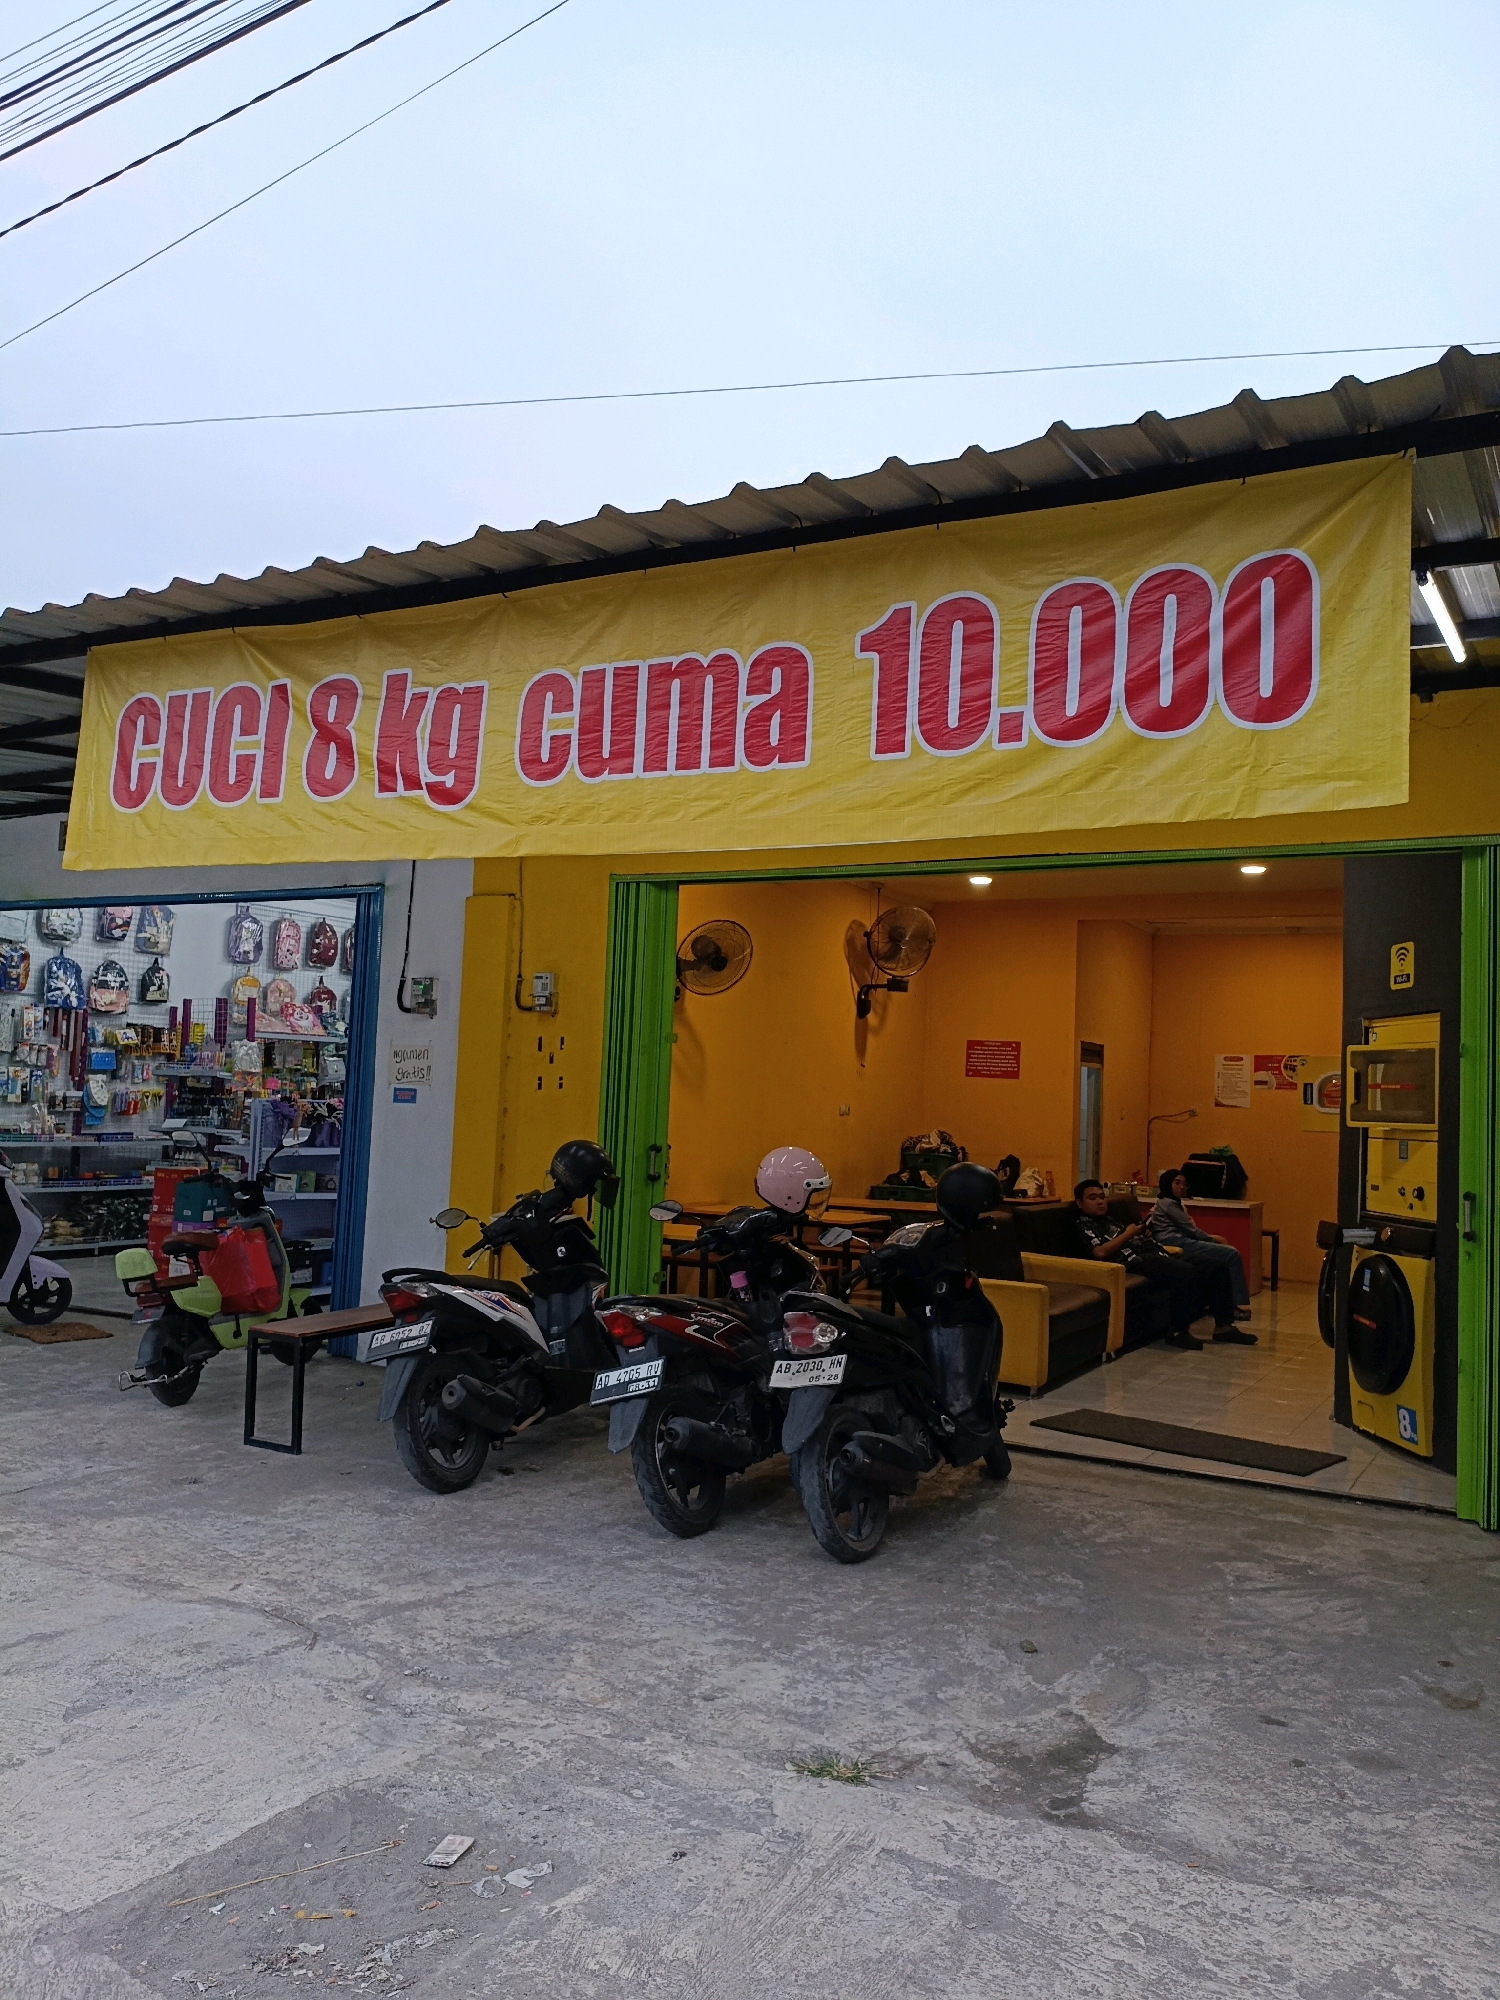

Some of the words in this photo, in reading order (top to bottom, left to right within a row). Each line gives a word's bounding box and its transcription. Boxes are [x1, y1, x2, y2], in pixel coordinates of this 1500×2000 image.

[111, 678, 292, 813] CUCI
[303, 673, 363, 802] 8
[374, 668, 489, 811] kg
[515, 641, 815, 787] cuma
[854, 548, 1320, 761] 10.000
[775, 1363, 792, 1374] AB
[796, 1360, 824, 1374] 2030
[829, 1357, 844, 1369] HN
[1398, 1408, 1412, 1439] 8
